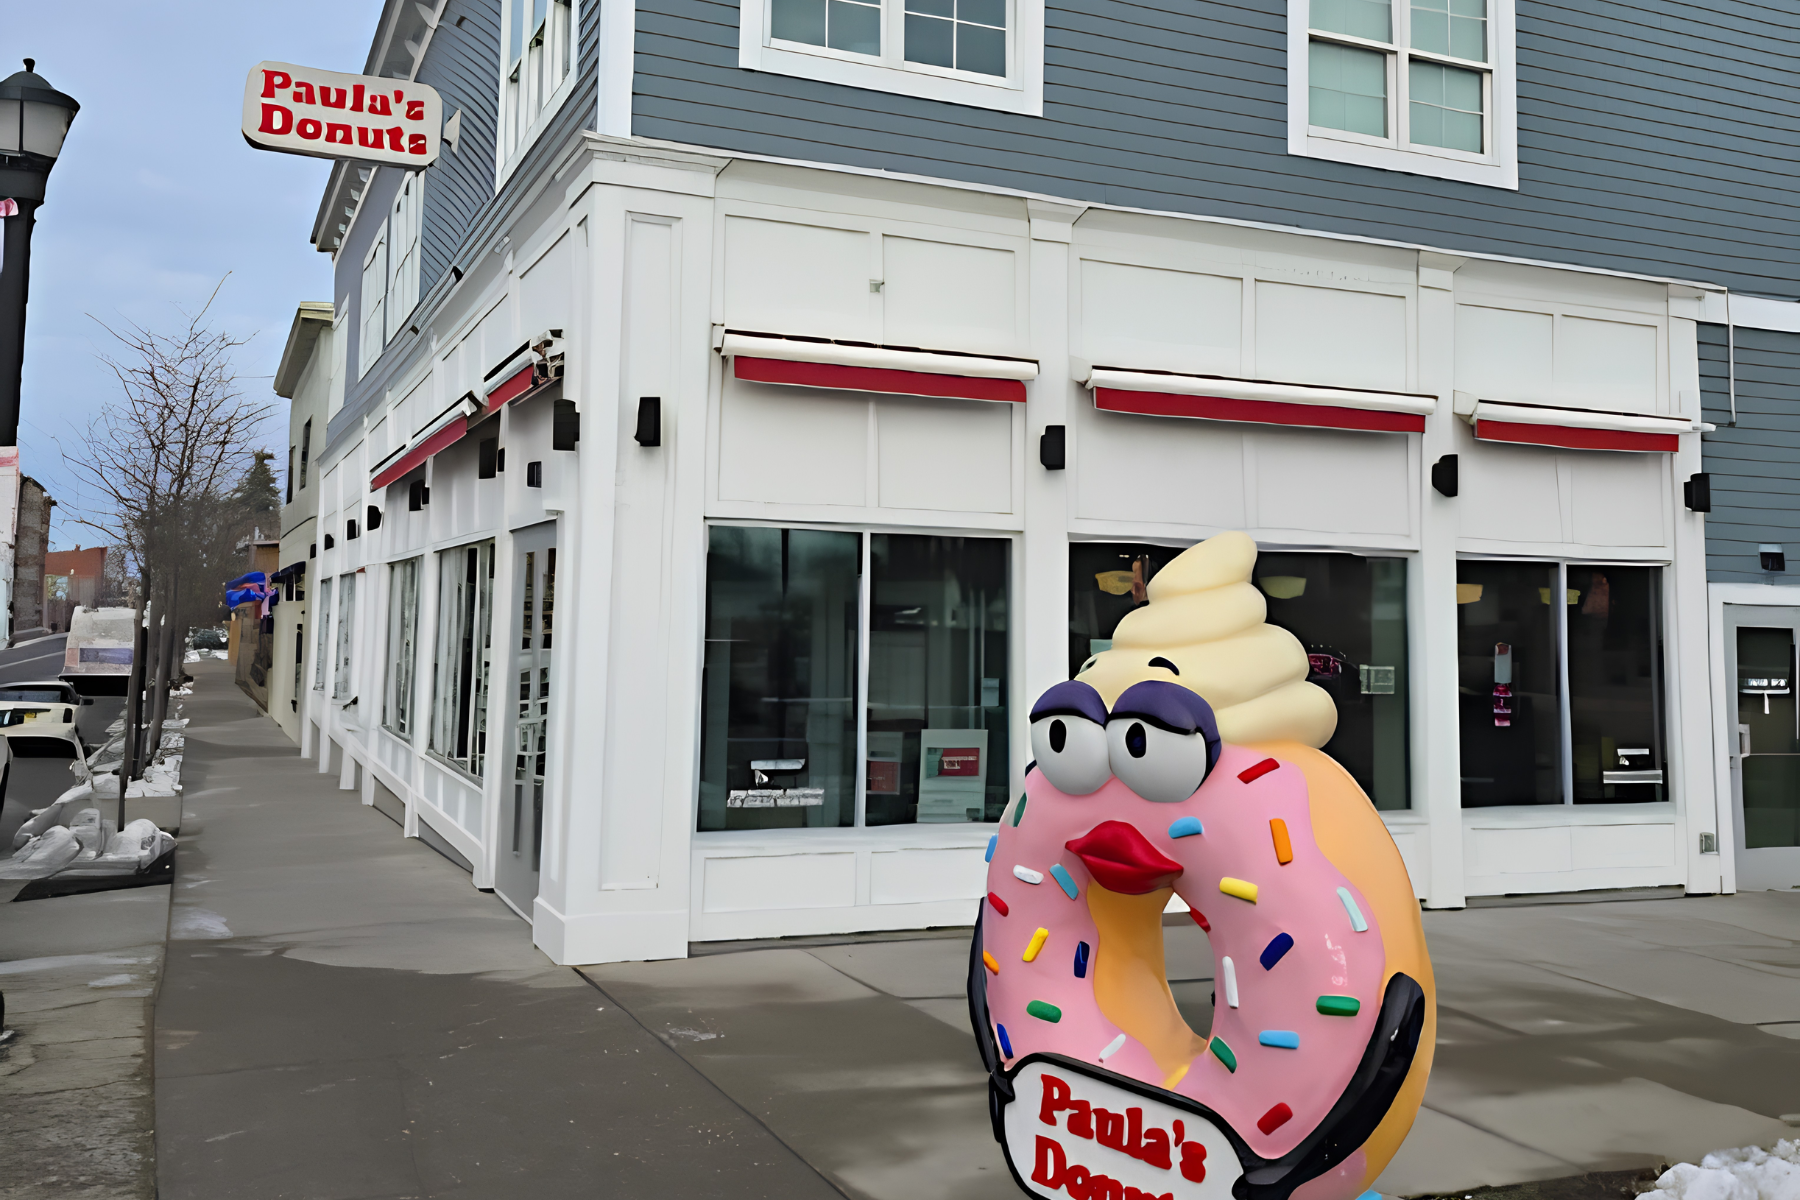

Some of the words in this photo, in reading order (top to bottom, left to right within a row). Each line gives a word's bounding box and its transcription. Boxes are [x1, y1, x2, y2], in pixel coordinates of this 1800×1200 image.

[260, 68, 425, 121] Paula's
[257, 102, 428, 156] Donuts
[1038, 1073, 1208, 1184] Paula's
